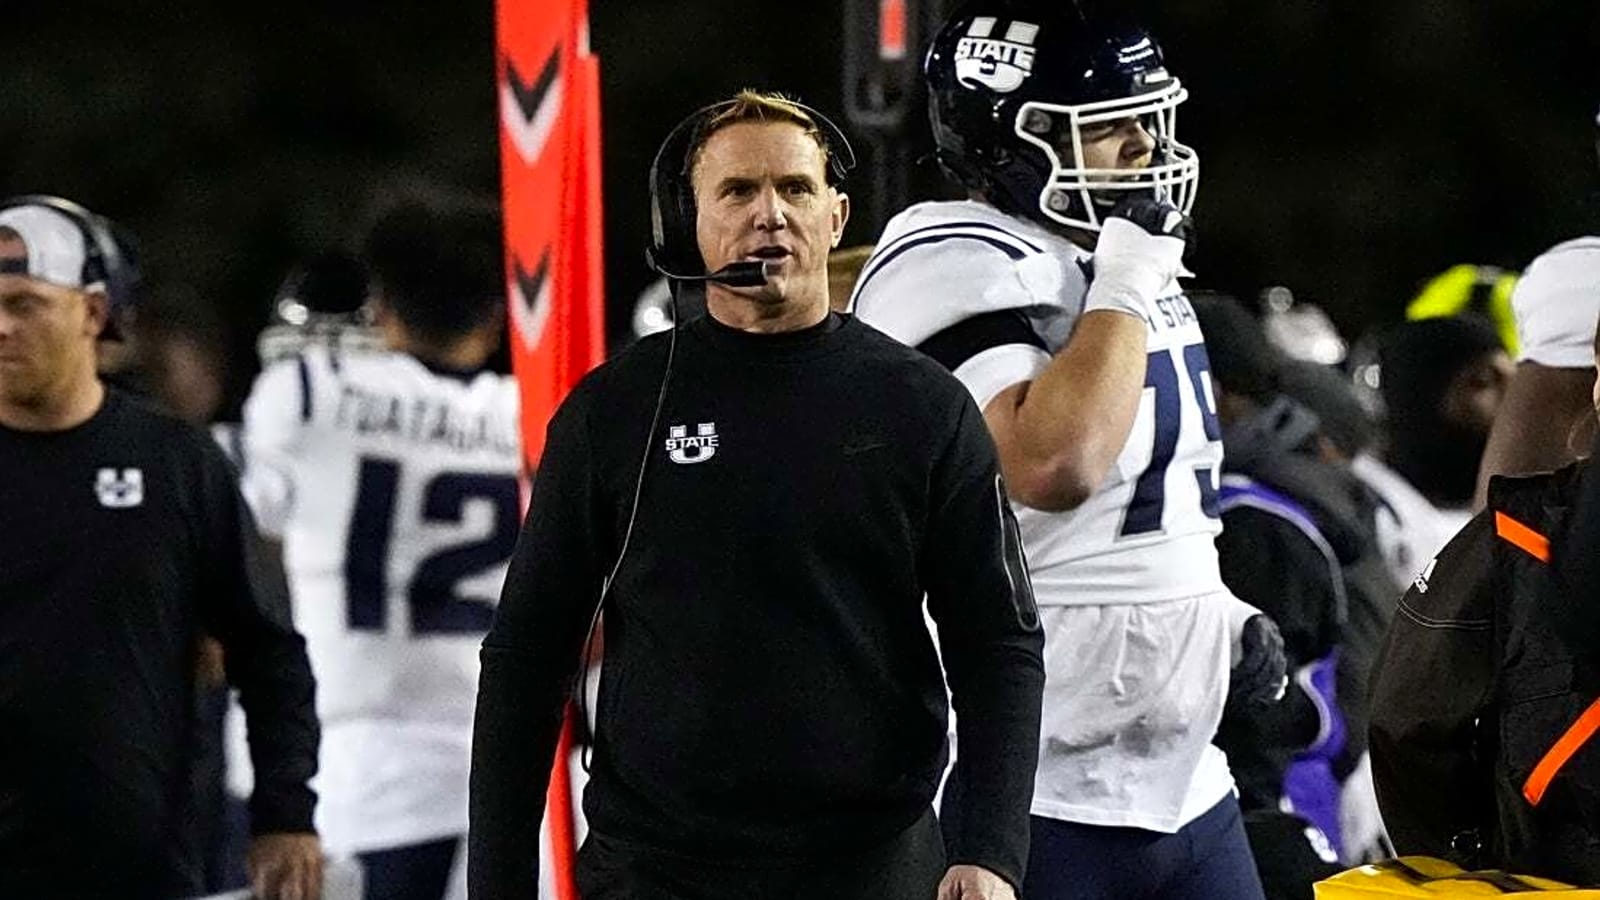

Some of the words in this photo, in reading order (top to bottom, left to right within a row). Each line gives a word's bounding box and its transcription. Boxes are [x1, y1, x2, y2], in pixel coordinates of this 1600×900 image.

[955, 37, 1037, 72] STATE
[665, 434, 719, 451] STATE
[345, 455, 520, 635] 12
